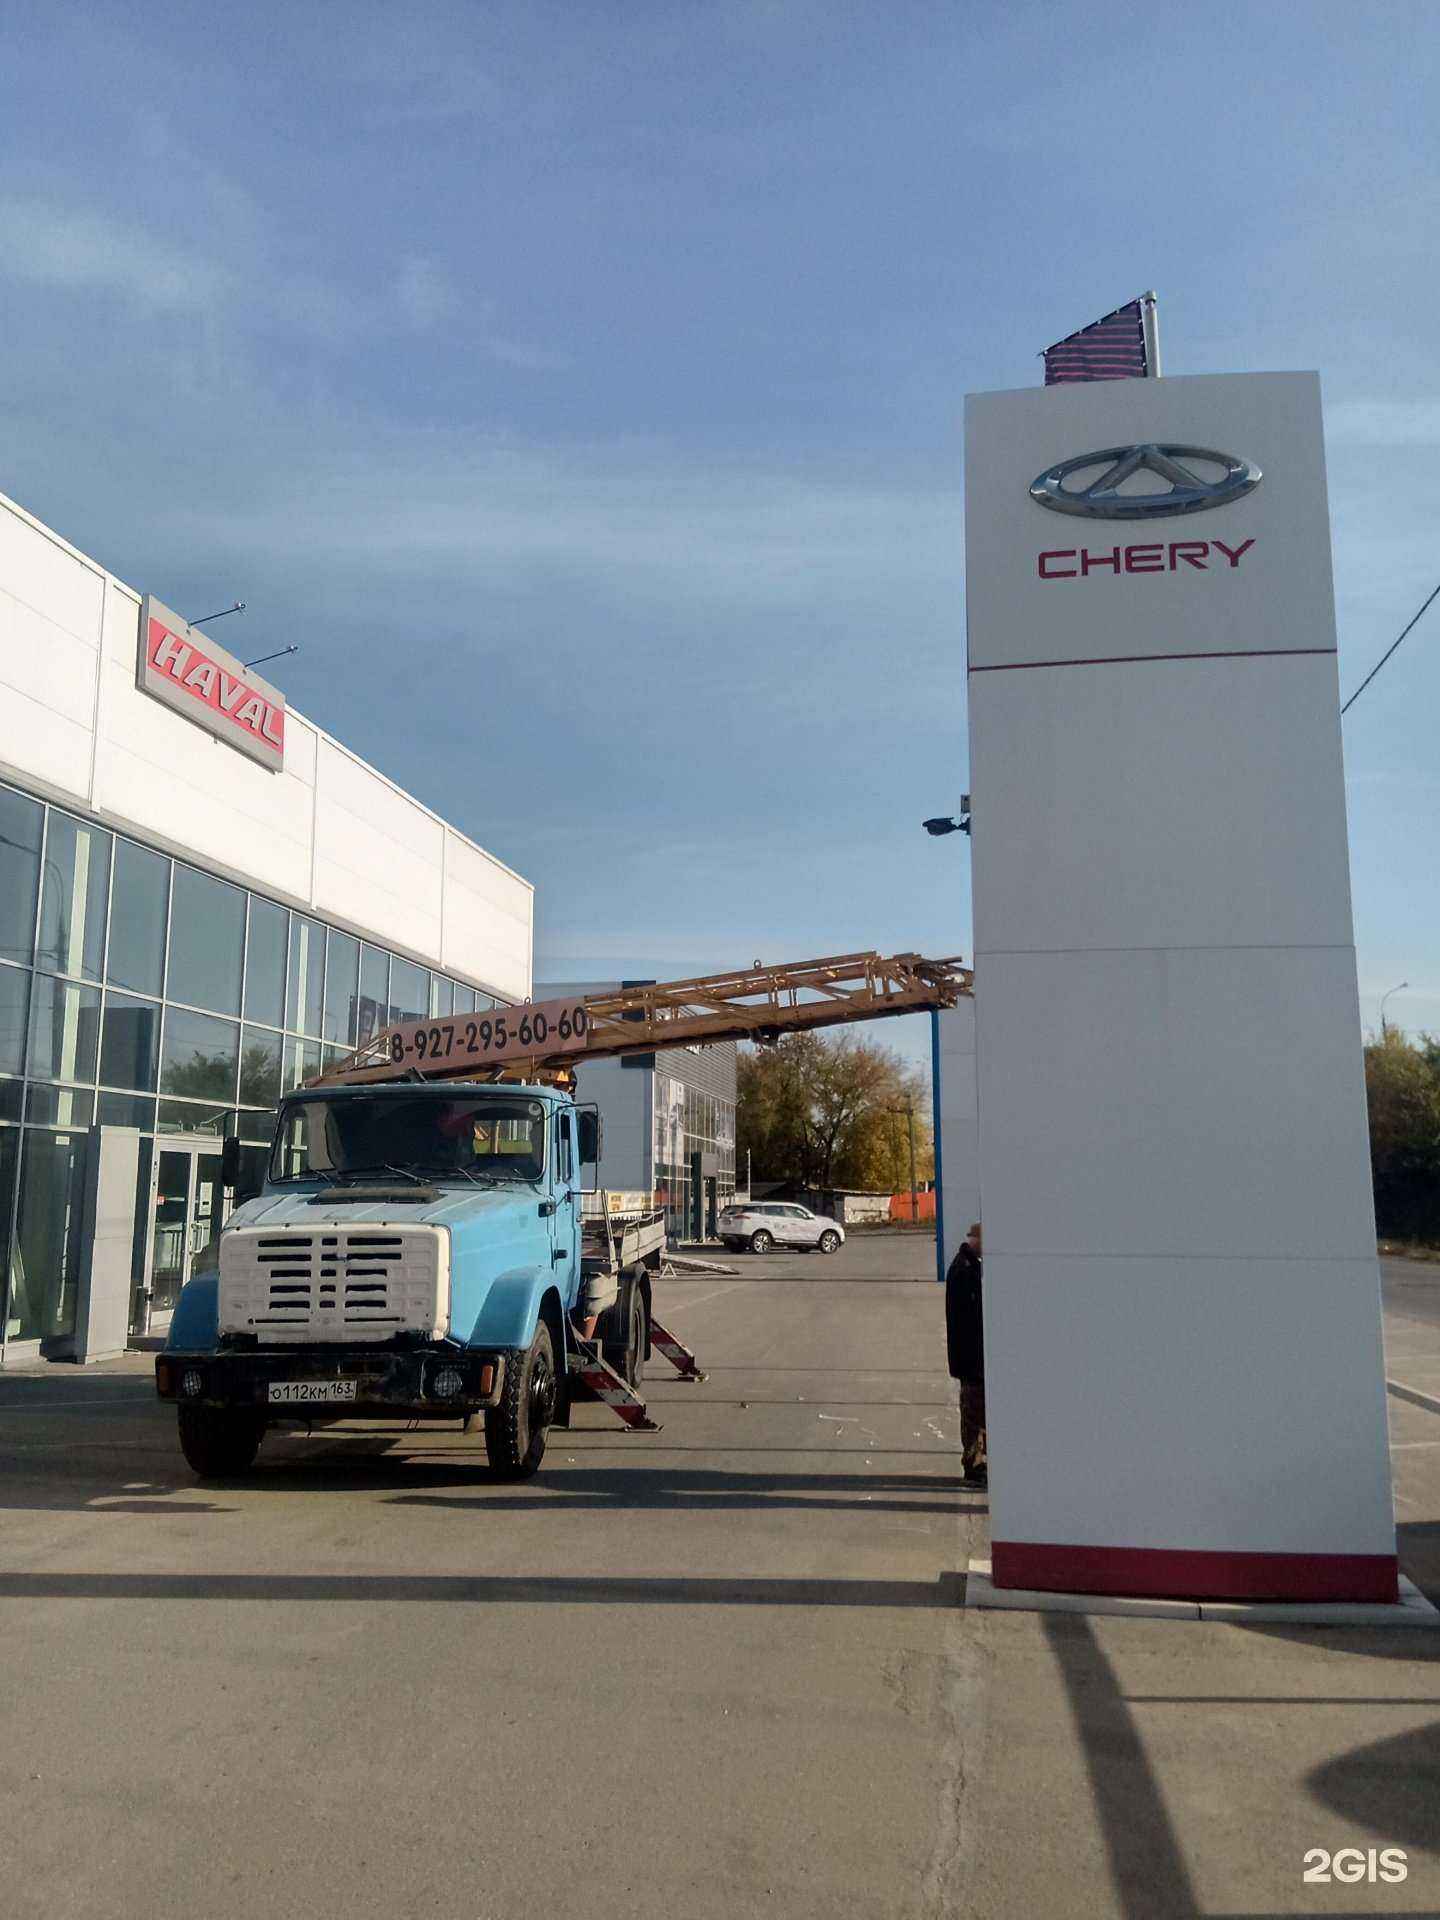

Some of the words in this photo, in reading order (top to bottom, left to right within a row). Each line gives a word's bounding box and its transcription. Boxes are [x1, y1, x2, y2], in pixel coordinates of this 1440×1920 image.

[1037, 538, 1256, 580] CHERY
[152, 631, 282, 746] HAVAL
[391, 1006, 587, 1063] 8-927-295-60-60
